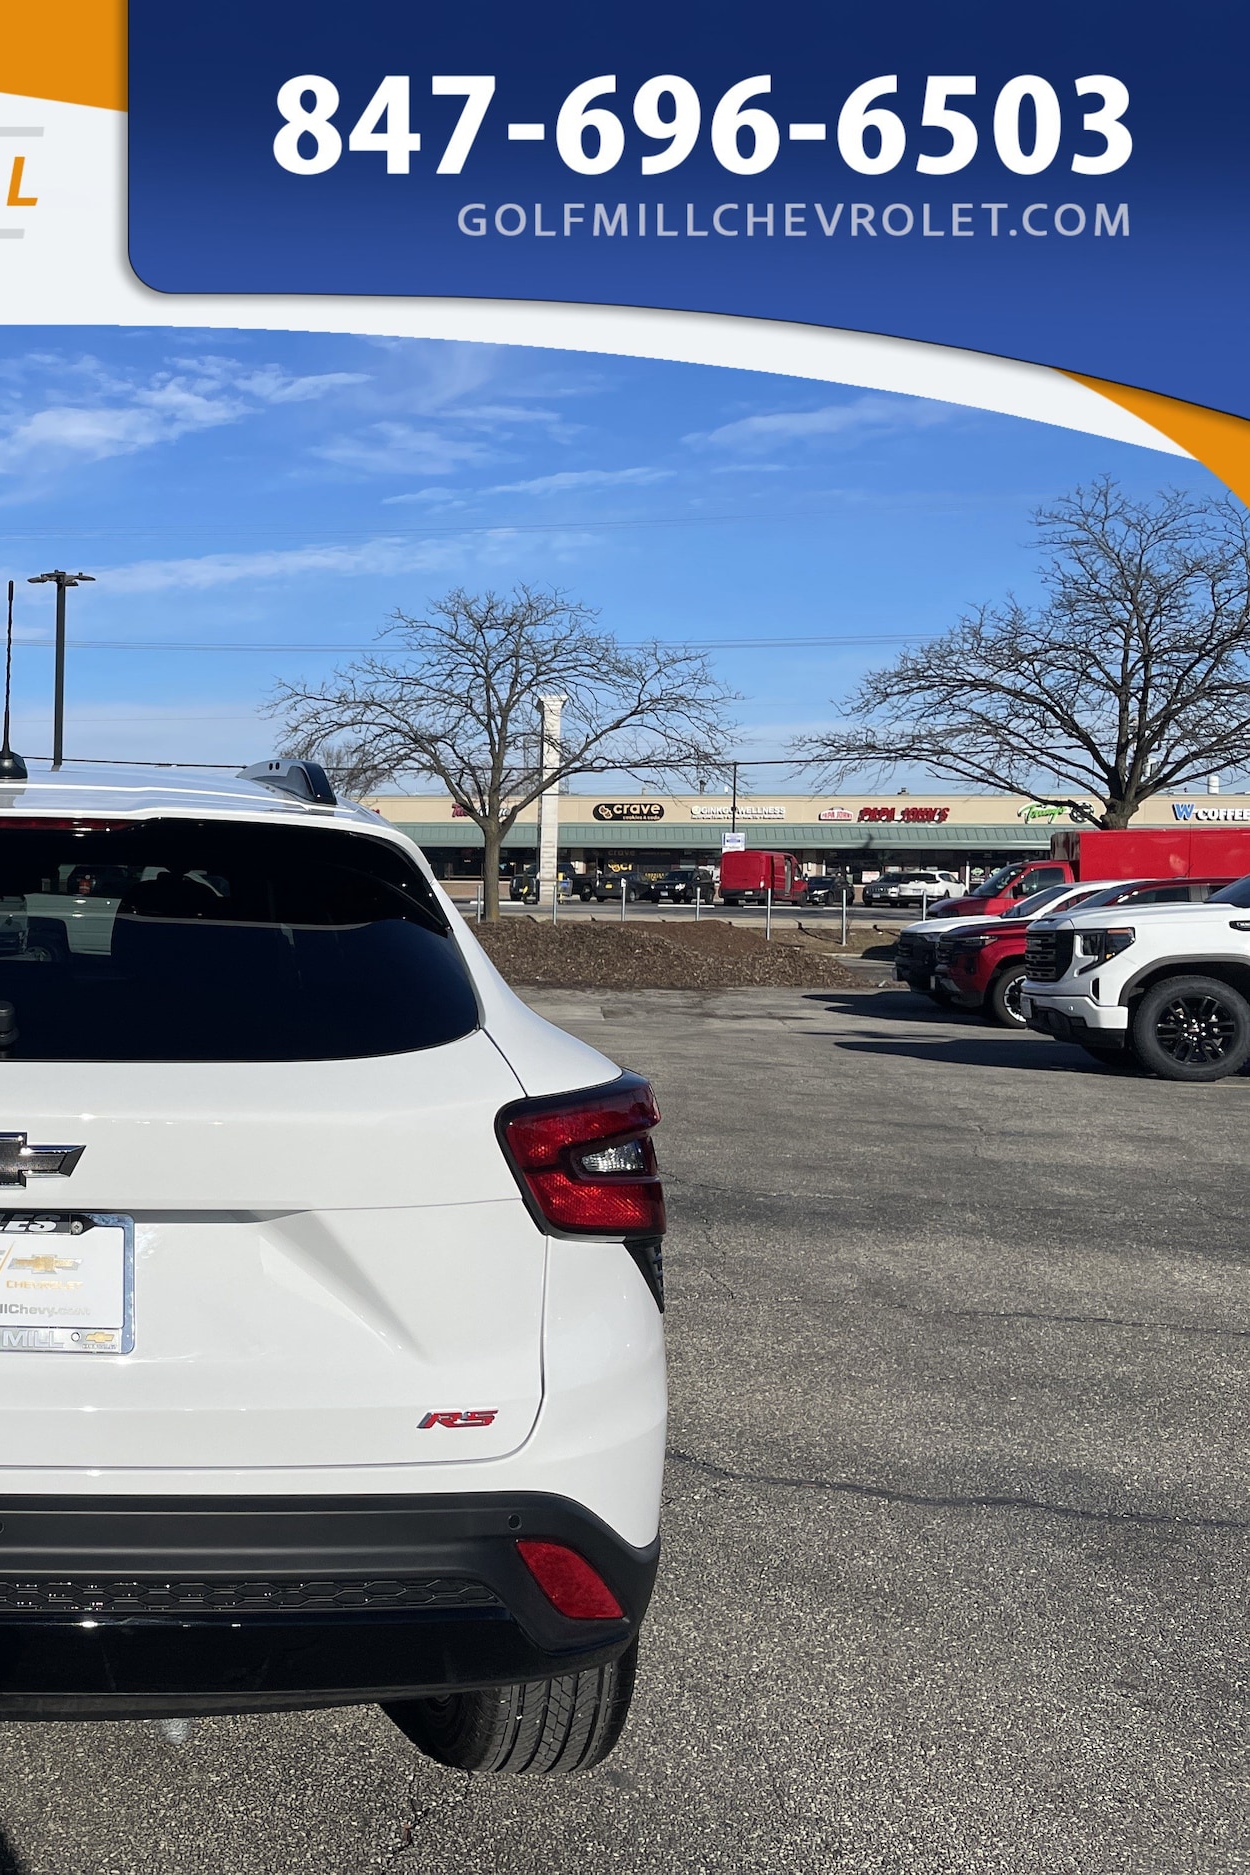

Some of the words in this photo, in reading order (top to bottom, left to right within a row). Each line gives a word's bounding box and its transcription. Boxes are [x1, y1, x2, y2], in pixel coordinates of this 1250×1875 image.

[612, 804, 661, 815] crave
[738, 806, 785, 815] WELLNESS
[858, 807, 896, 822] PAPA
[901, 807, 950, 823] JOHN'S
[2, 1329, 66, 1350] MILL
[416, 1409, 500, 1430] RS
